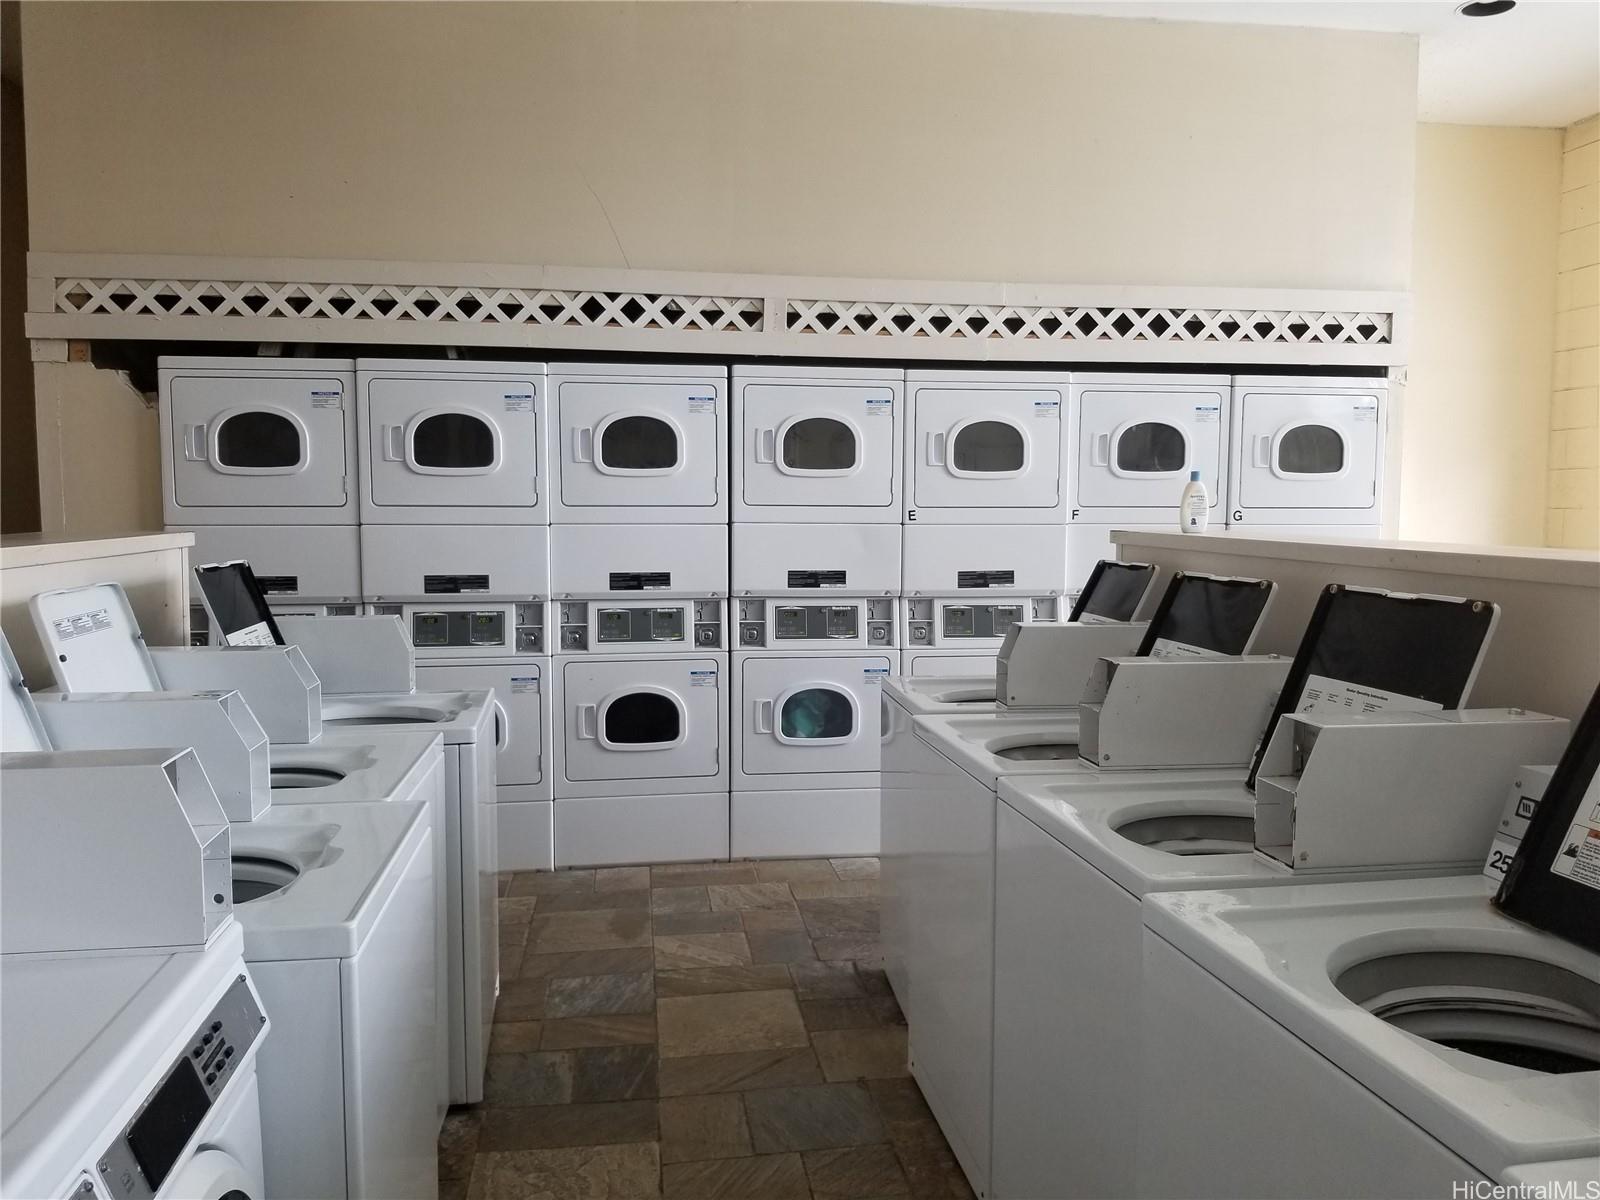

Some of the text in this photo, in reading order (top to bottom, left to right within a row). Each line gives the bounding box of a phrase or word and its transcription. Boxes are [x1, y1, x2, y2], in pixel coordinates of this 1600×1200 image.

[908, 509, 917, 521] E
[1072, 509, 1080, 520] F
[1232, 509, 1243, 521] G
[1489, 850, 1512, 874] 25
